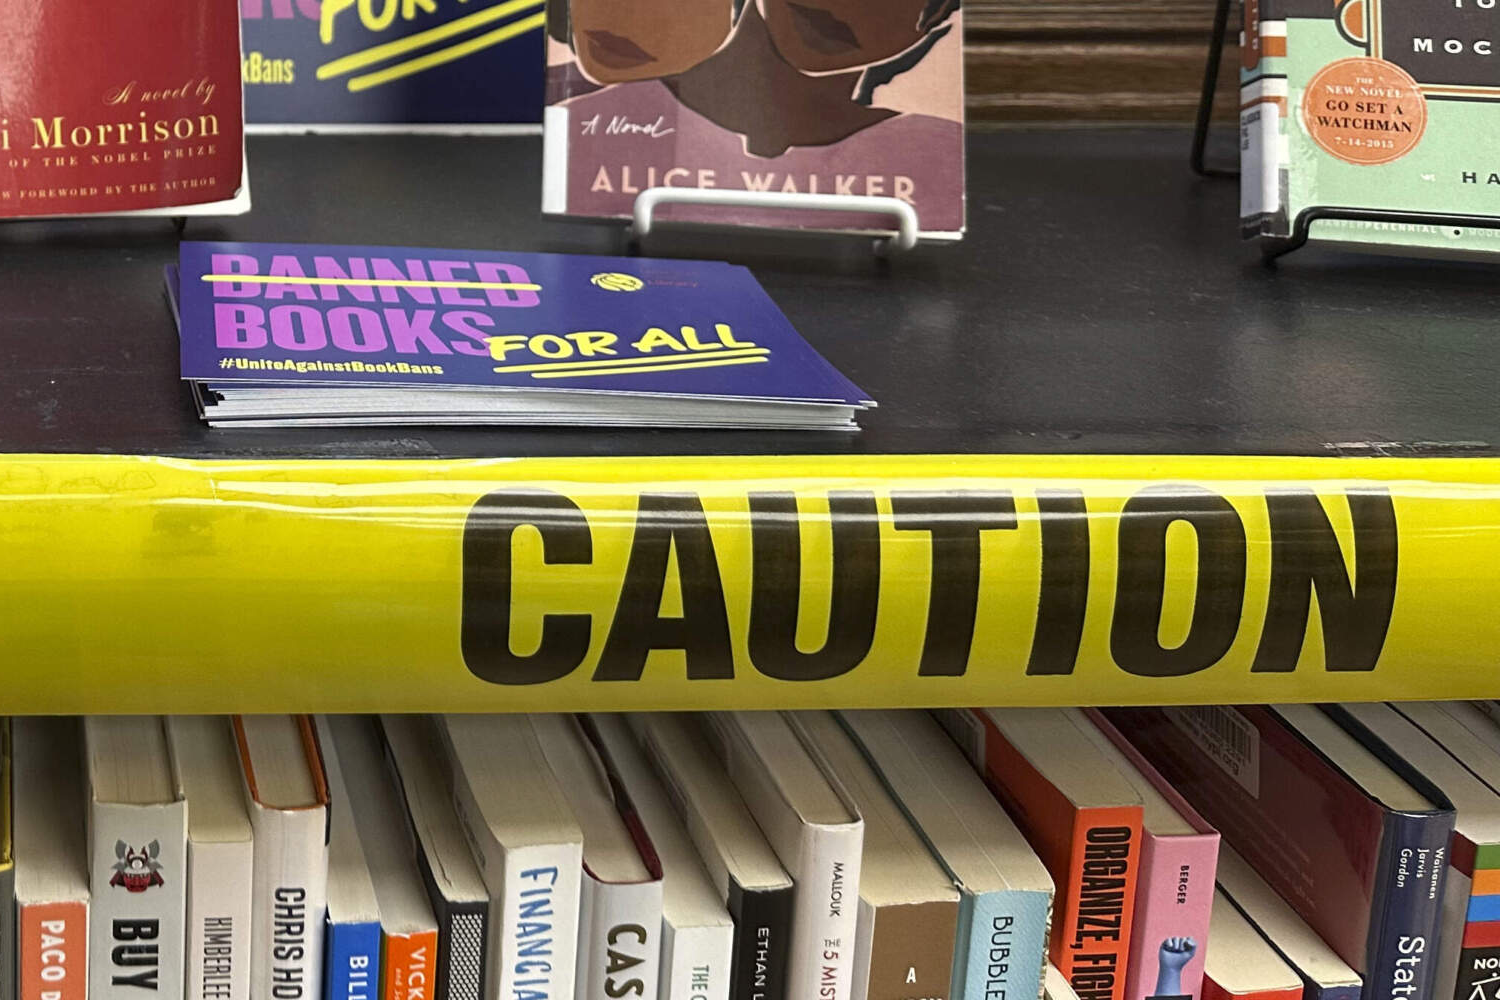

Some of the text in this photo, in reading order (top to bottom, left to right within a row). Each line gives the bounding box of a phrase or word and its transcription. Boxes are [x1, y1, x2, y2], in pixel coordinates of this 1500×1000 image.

[1413, 38, 1492, 55] MOC
[104, 76, 216, 105] A novel by
[1325, 85, 1403, 98] NEW NOVEL
[1356, 77, 1374, 85] THE
[1317, 116, 1412, 133] WATCHMAN
[1326, 100, 1403, 115] GO SET A
[31, 111, 220, 150] Morrison
[581, 114, 674, 137] A Novel
[1335, 136, 1395, 149] 7-14-2015
[9, 158, 30, 169] OF
[43, 157, 78, 167] THE
[92, 152, 151, 164] NOBEL
[164, 144, 217, 160] PRIZE
[20, 187, 97, 199] FOREWORD
[106, 185, 122, 195] BY
[130, 183, 156, 193] THE
[164, 177, 216, 191] AUTHOR
[591, 166, 917, 204] ALICE WALKER
[212, 254, 542, 309] BANNED
[214, 302, 756, 361] BOOKS FOR ALL
[219, 358, 444, 375] #UniteAgainstBookBans
[460, 484, 1399, 686] CAUTION
[1397, 848, 1413, 888] Gordon
[1416, 848, 1430, 879] Jarvis
[1429, 847, 1445, 899] Waisanen
[829, 861, 844, 917] MALLOUK
[1070, 826, 1133, 950] ORGANIZE,
[1176, 865, 1190, 905] BERGER
[272, 887, 306, 961] CHRIS
[40, 920, 66, 982] PACO
[111, 918, 159, 990] BUY
[203, 917, 232, 999] KIMBERLEE
[754, 927, 770, 986] ETHAN
[823, 950, 839, 960] 5
[691, 964, 709, 991] THE
[905, 966, 917, 984] A
